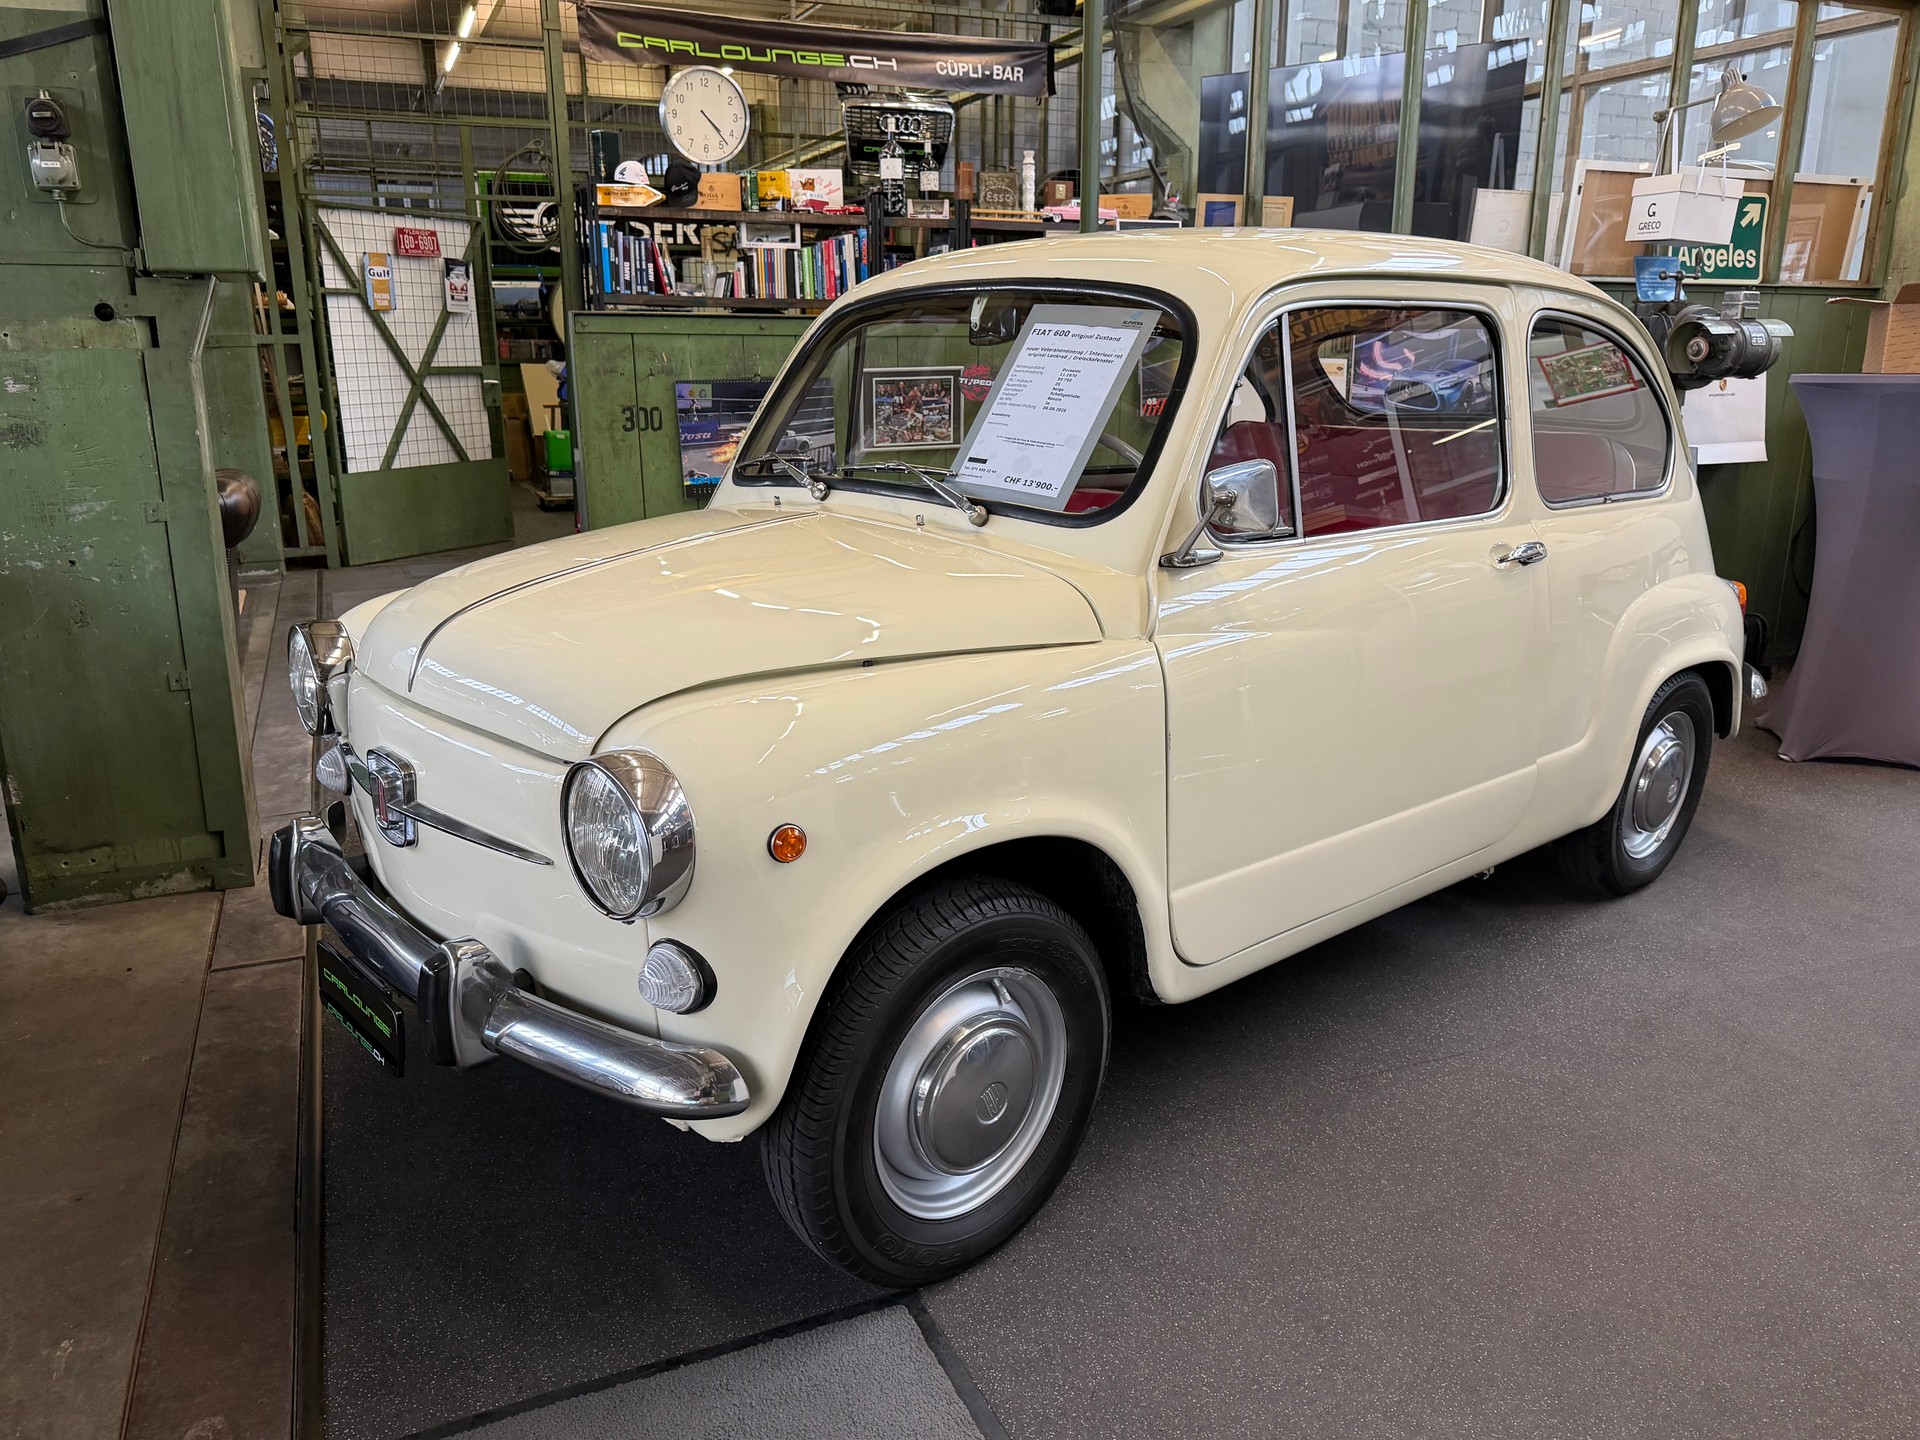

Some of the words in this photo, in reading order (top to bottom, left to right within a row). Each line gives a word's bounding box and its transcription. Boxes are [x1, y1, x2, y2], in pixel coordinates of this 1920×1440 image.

[616, 31, 897, 71] CARLOUNGE.CH
[686, 82, 693, 91] 11
[700, 78, 708, 88] 12
[718, 84, 720, 93] 1
[676, 94, 684, 104] 10
[728, 96, 732, 106] 2
[672, 109, 677, 118] 9
[732, 114, 738, 122] 3
[676, 126, 682, 135] 8
[729, 129, 734, 138] 4
[688, 138, 694, 148] 7
[718, 140, 724, 150] 5
[704, 144, 710, 154] 6
[1647, 202, 1656, 218] G
[1638, 220, 1662, 231] GRECO
[1678, 243, 1757, 273] Angeles
[368, 268, 390, 278] Gulf
[1031, 328, 1052, 336] FIAT
[1054, 330, 1070, 338] 600
[1072, 332, 1094, 340] original
[1095, 334, 1121, 342] Zustand
[1072, 355, 1114, 364] Dreiecksfenster
[621, 406, 662, 432] 300
[1004, 475, 1021, 485] CHF
[1022, 478, 1058, 491] 13'900.-
[324, 968, 391, 1039] CARLOUNGE
